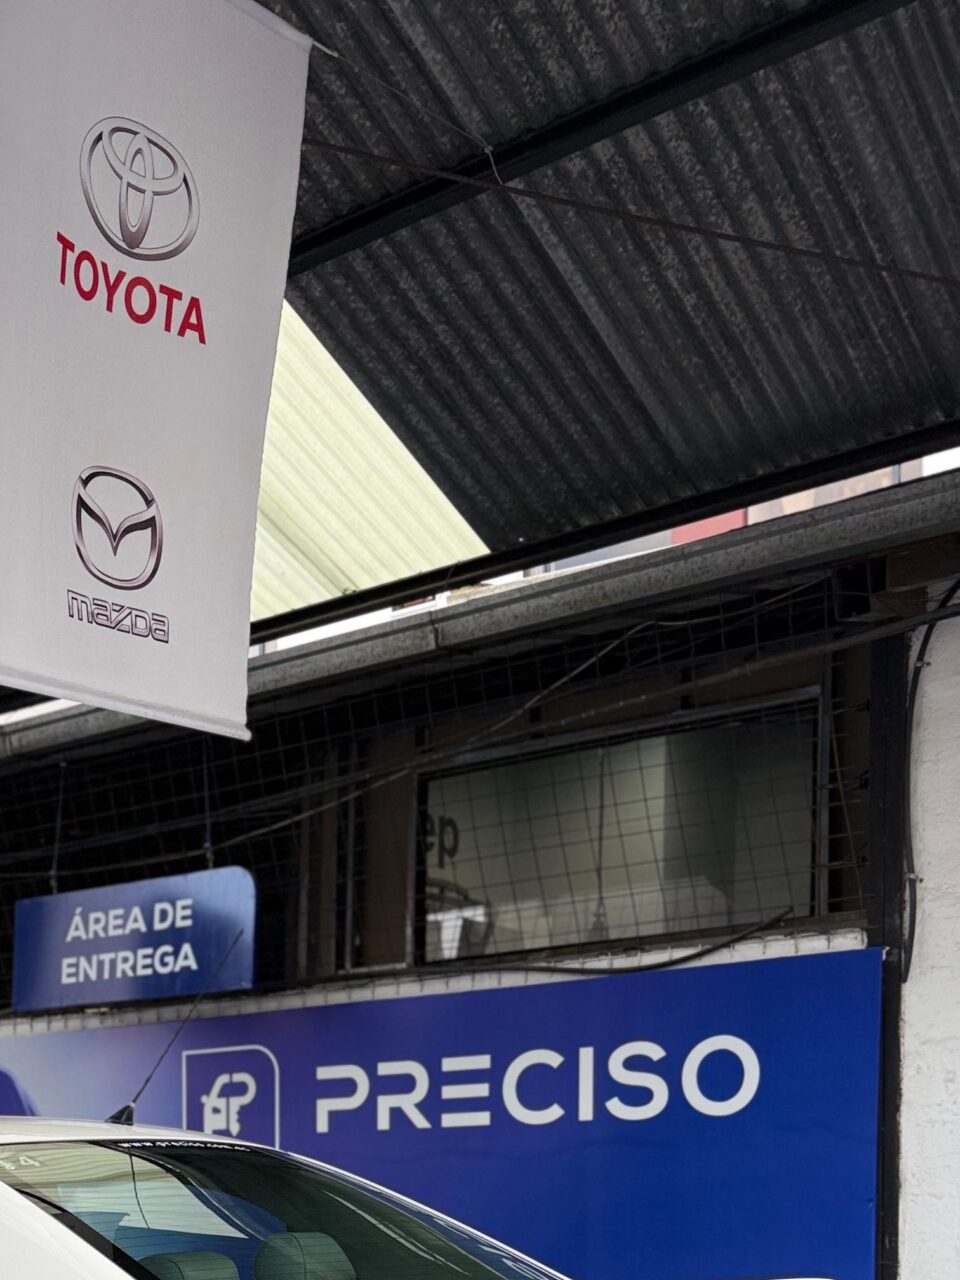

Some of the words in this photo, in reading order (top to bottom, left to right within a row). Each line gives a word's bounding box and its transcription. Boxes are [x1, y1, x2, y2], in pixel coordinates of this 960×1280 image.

[57, 231, 207, 345] TOYOTA
[65, 906, 147, 943] ÁREA
[153, 898, 193, 932] DE
[60, 942, 199, 985] ENTREGA
[315, 1034, 761, 1135] PRECISO
